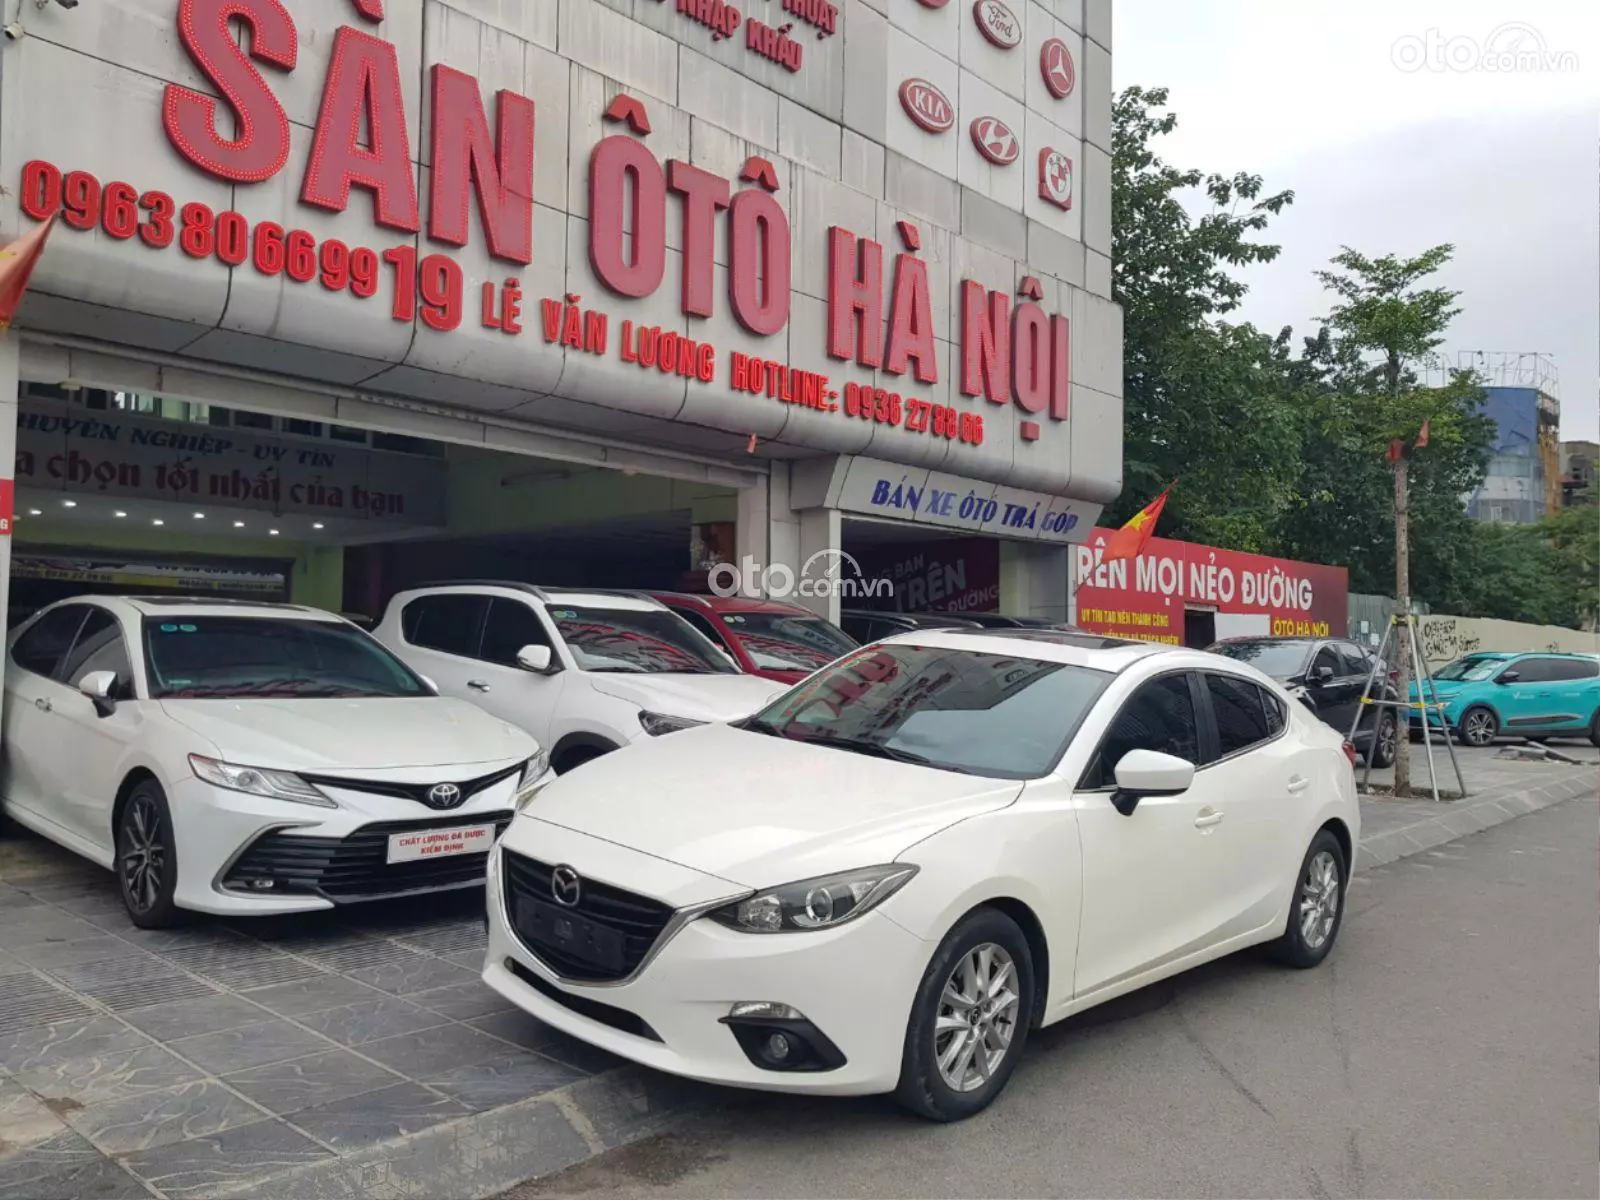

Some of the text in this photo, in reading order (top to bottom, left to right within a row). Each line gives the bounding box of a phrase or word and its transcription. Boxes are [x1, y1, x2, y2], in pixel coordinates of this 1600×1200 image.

[915, 89, 946, 121] KIA
[588, 93, 790, 335] ÔTÔ
[826, 220, 938, 384] HÀ
[960, 275, 1069, 442] NỘI
[383, 244, 464, 331] 19
[482, 277, 522, 334] LÊ
[541, 292, 608, 355] VĂN
[621, 319, 715, 382] LƯƠNG
[730, 351, 839, 412] HOTLINE:
[46, 451, 141, 490] chọn
[871, 475, 924, 512] BÁN
[925, 489, 957, 516] XE
[1041, 506, 1078, 534] GÓP
[1136, 554, 1184, 605] MỌI
[1190, 552, 1235, 602] NẺO
[1242, 565, 1312, 611] ĐƯỜNG
